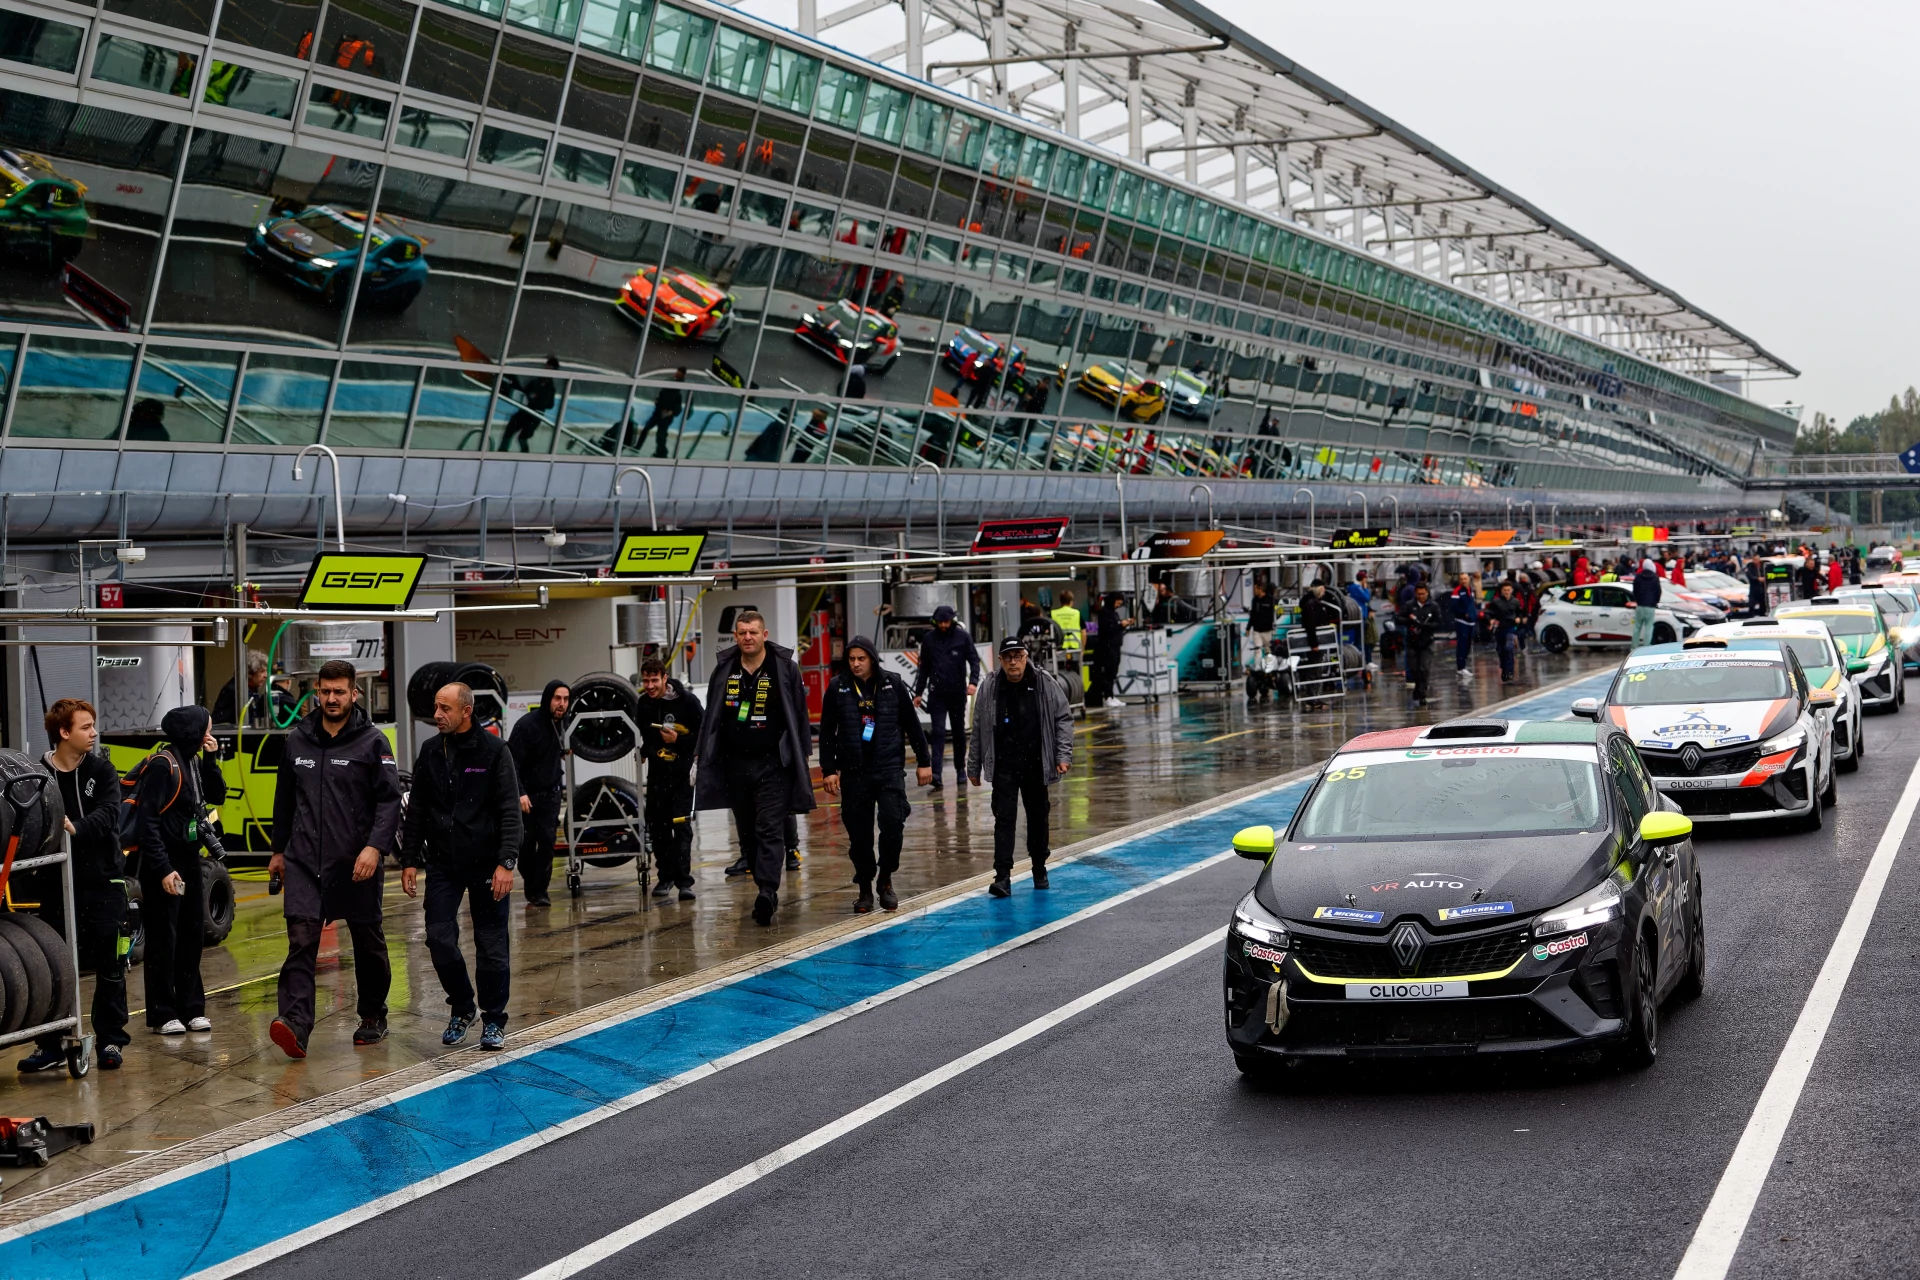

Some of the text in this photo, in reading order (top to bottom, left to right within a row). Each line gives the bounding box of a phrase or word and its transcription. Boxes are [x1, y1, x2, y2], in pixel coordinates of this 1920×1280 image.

[984, 527, 1059, 538] EASTALENT
[627, 547, 690, 560] GSP
[321, 572, 404, 589] GSP
[101, 587, 121, 601] 57
[1626, 660, 1706, 674] EXPLORER
[1628, 673, 1647, 683] 16
[1667, 723, 1719, 732] SITAB
[1435, 746, 1520, 756] Castrol
[1763, 763, 1786, 771] Castrol
[1326, 766, 1367, 783] 65
[1370, 880, 1464, 893] VR AUTO
[1333, 911, 1375, 920] MICHELIN
[1460, 905, 1505, 915] MICHELIN
[1547, 932, 1588, 954] Castrol
[1251, 945, 1287, 964] Castrol
